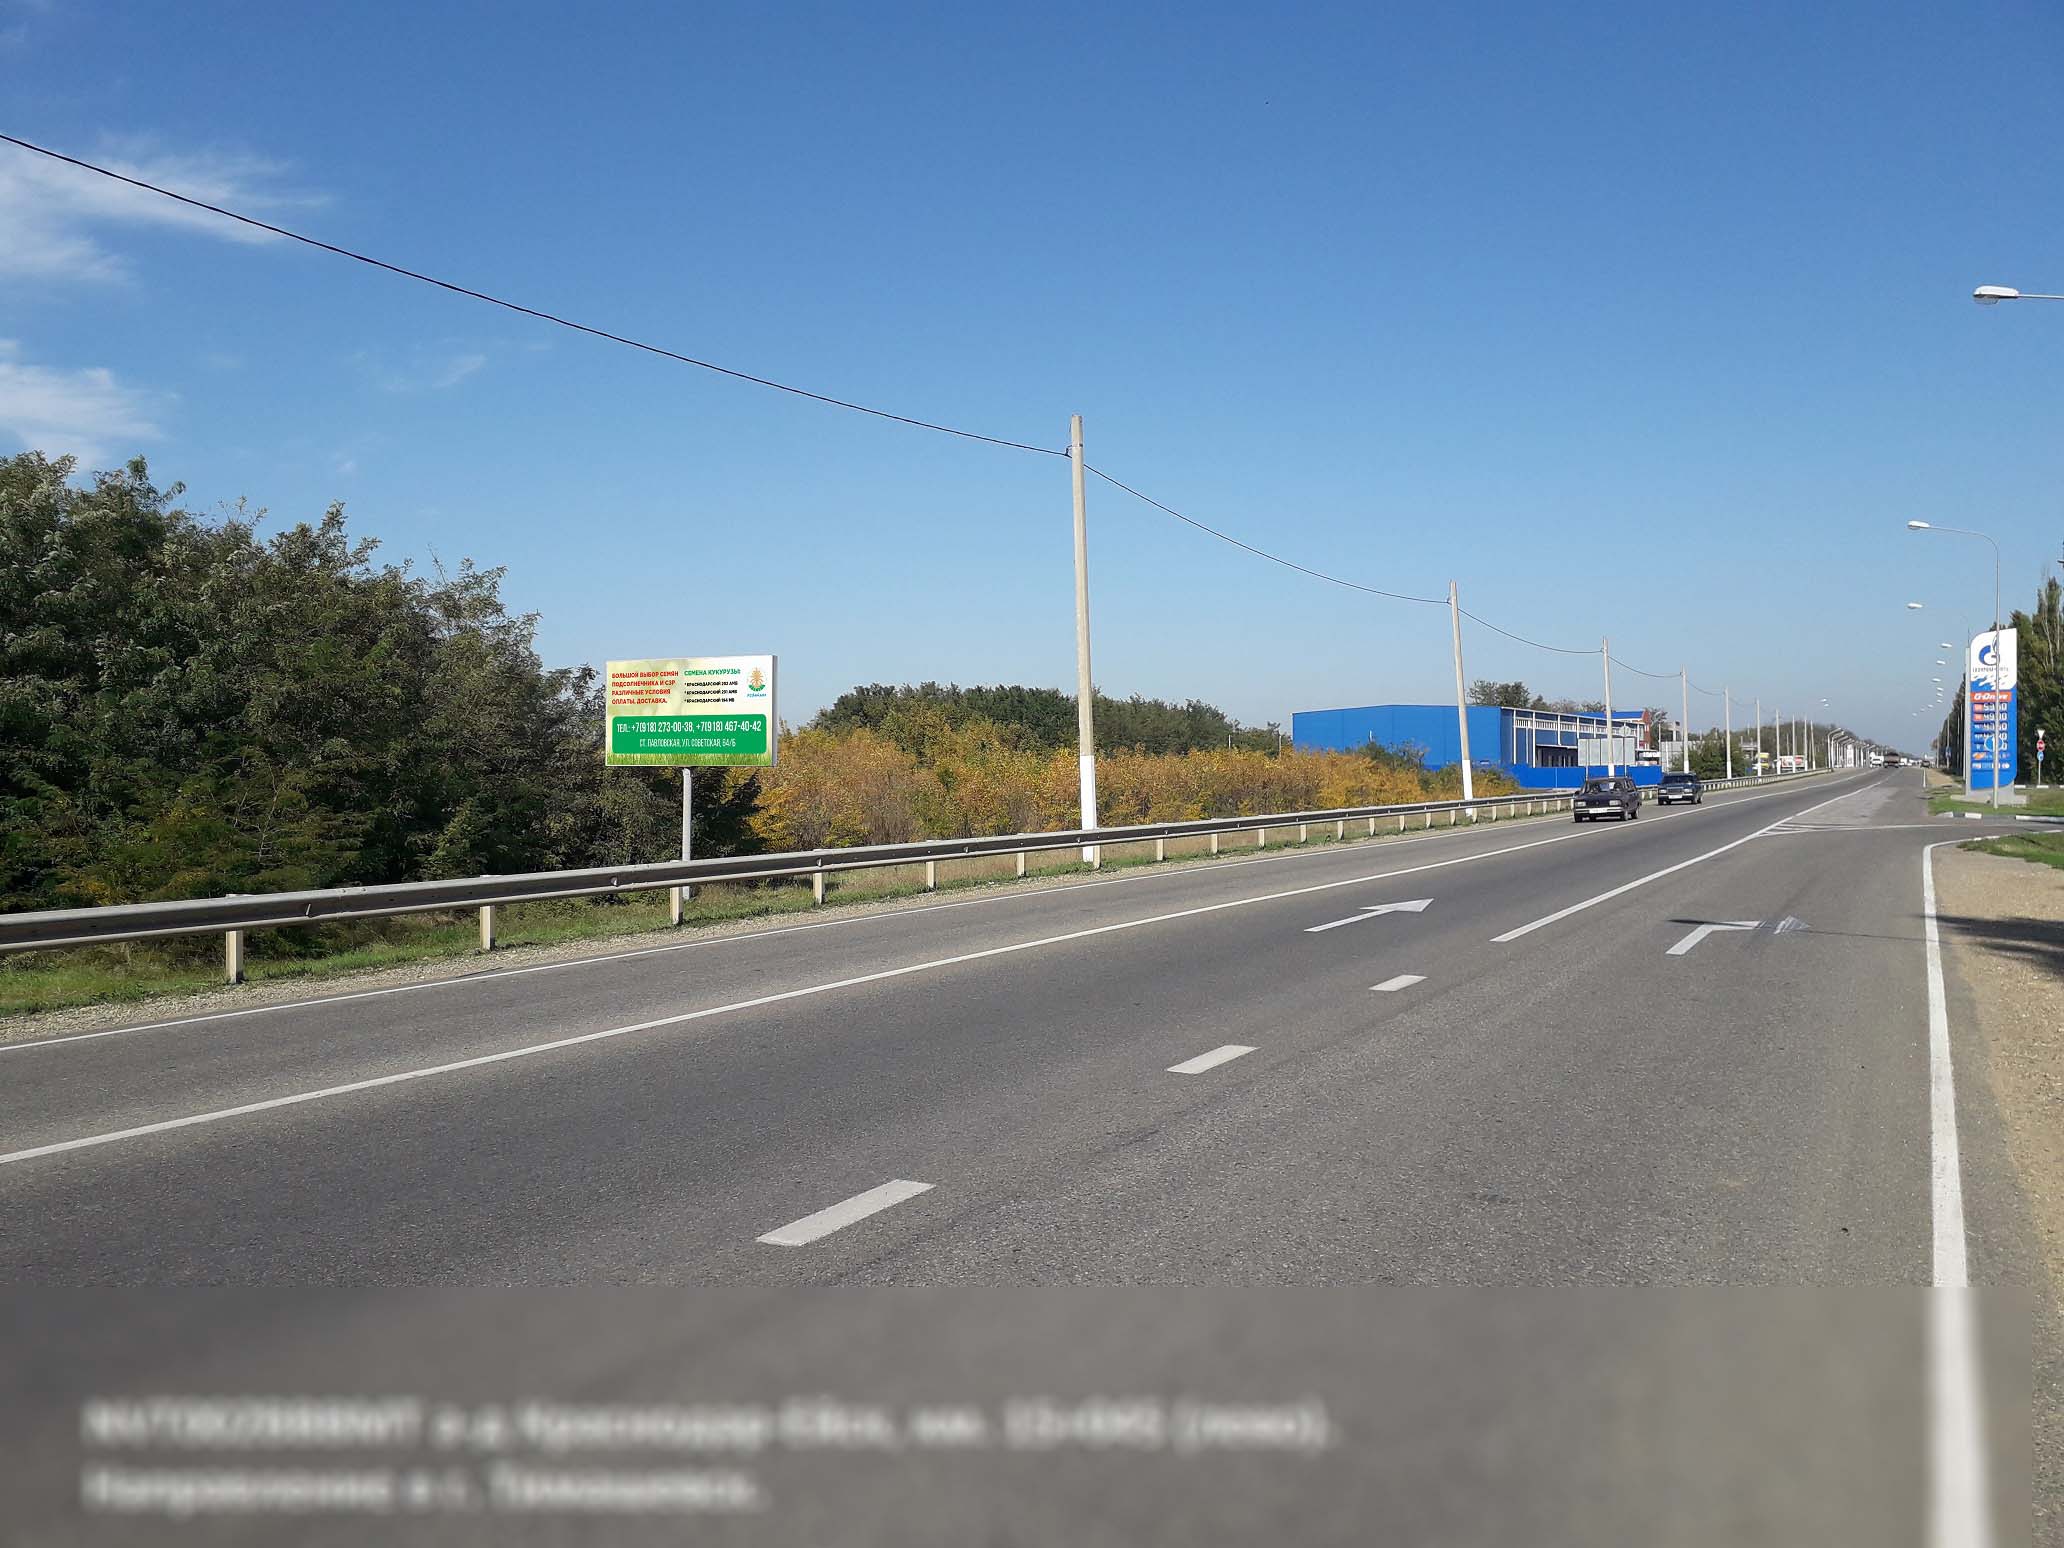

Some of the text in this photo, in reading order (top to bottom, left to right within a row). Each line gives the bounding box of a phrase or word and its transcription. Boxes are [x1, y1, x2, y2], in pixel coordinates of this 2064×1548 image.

[1973, 692, 2008, 701] G-Drve
[631, 722, 657, 733] +7(918)
[695, 721, 723, 732] +7(918)
[724, 720, 762, 732] 467-40-42
